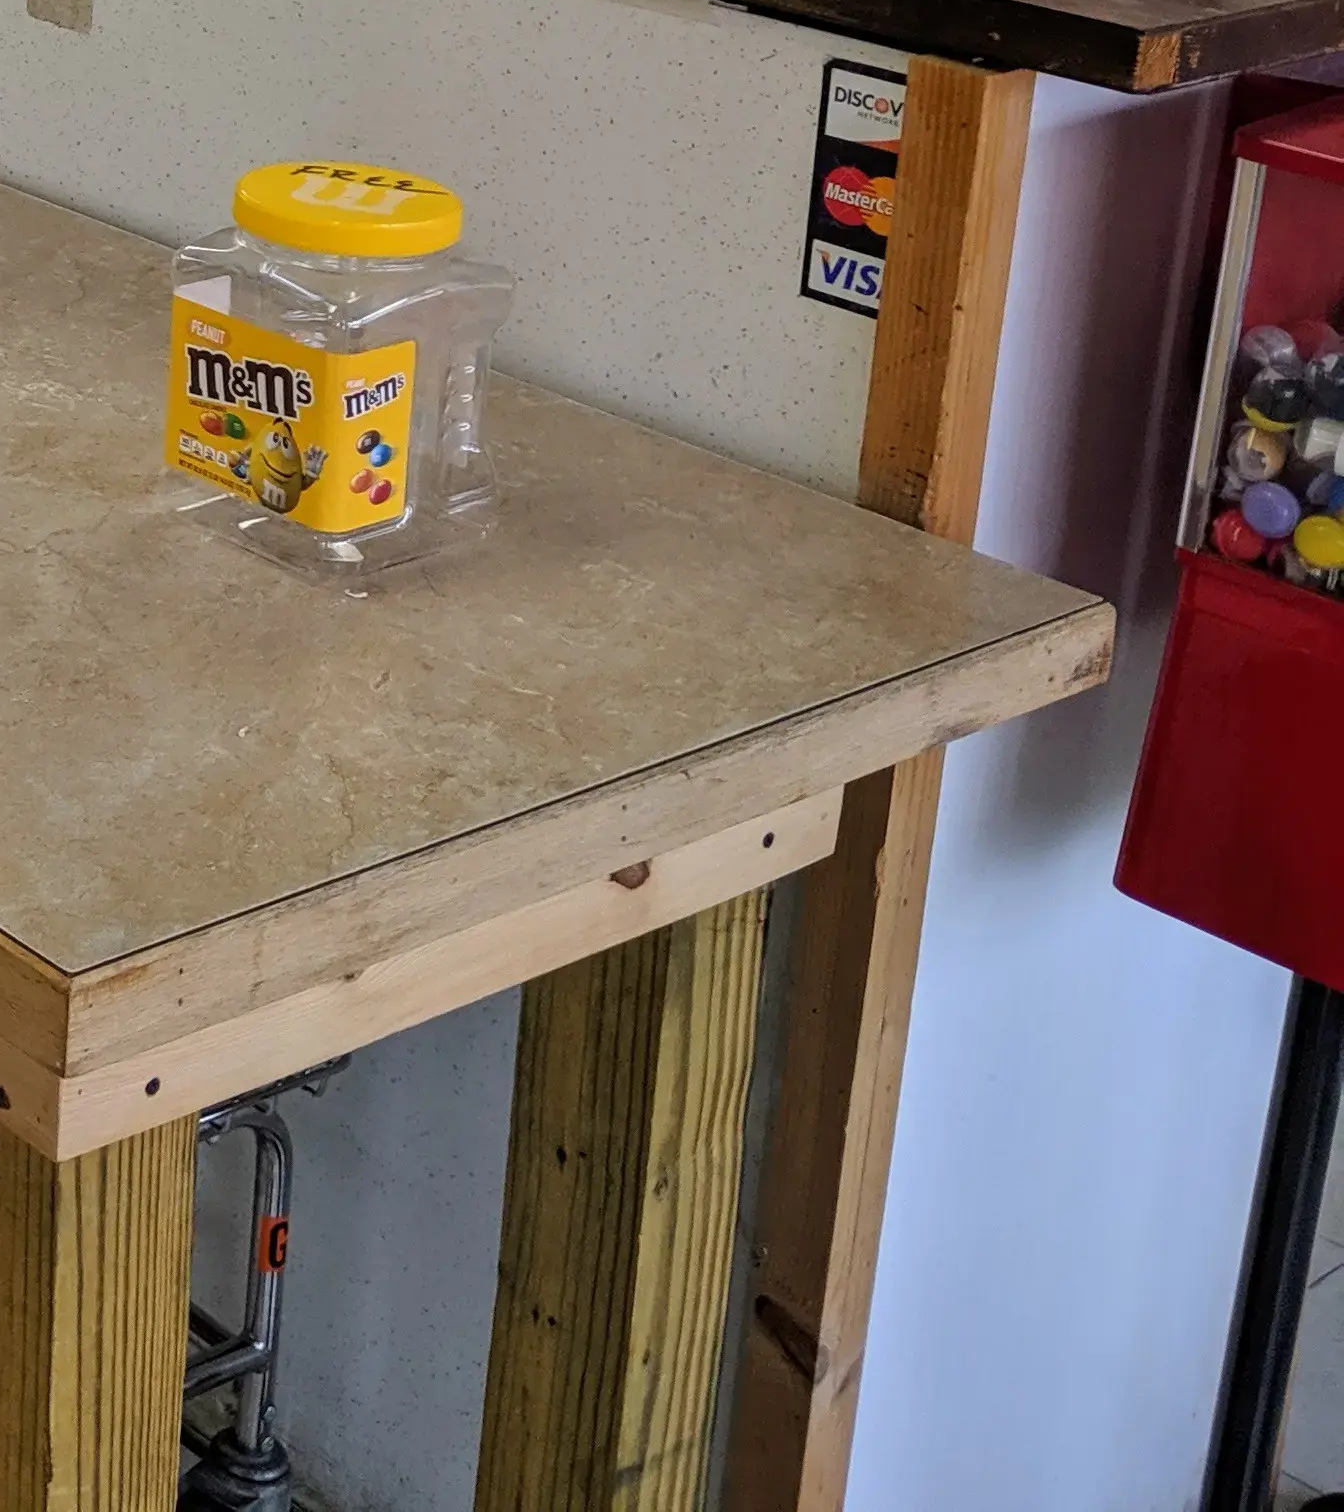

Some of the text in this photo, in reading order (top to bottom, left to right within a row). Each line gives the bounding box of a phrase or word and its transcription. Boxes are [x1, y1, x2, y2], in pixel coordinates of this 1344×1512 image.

[290, 165, 449, 196] FREE
[817, 252, 882, 298] VIS
[191, 319, 225, 344] PEANUT
